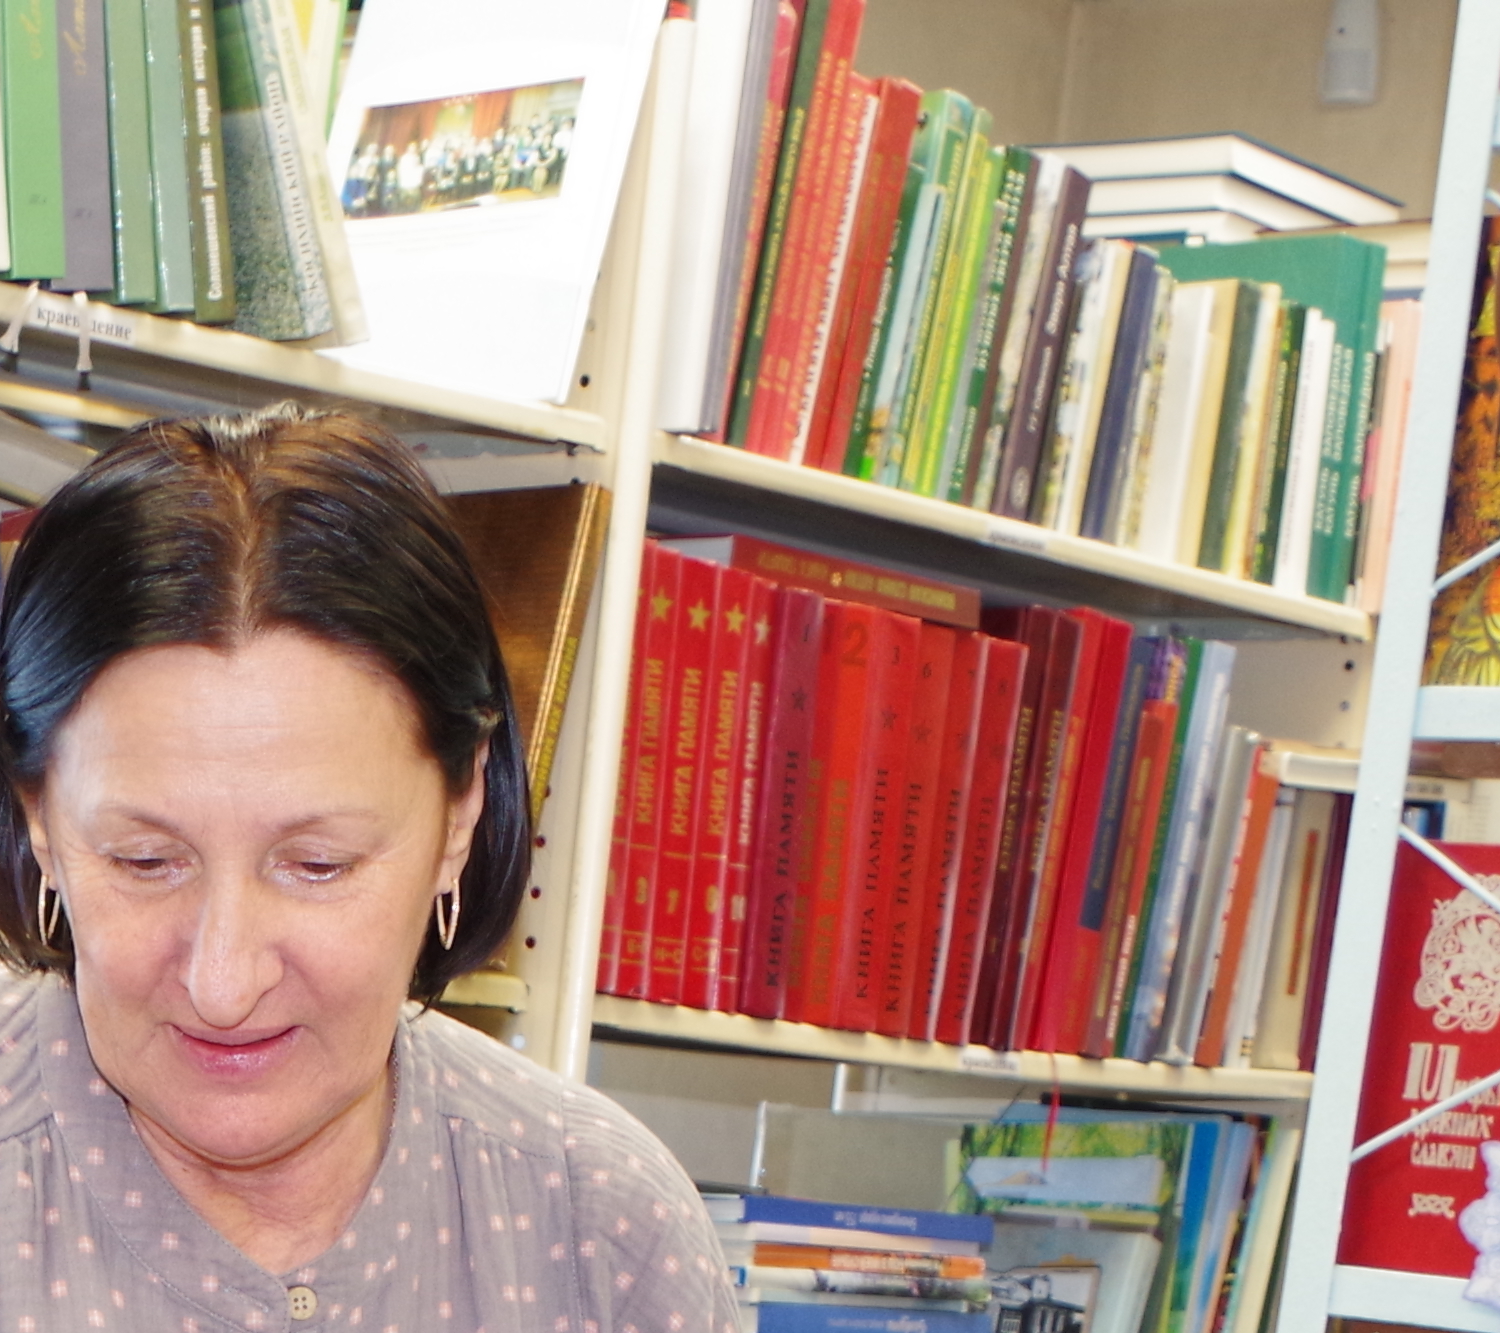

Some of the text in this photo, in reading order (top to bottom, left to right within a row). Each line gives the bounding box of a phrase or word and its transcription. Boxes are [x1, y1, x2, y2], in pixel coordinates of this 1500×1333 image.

[188, 23, 209, 81] истории
[193, 86, 213, 136] очерки
[839, 620, 871, 669] 2
[632, 656, 665, 824] КНИГА ПАМЯТИ
[668, 666, 702, 835] КНИГА ПАМЯТИ
[705, 668, 740, 835] КНИГА ПАМЯТИ
[736, 679, 766, 846] КНИГА ПАМЯТИ
[764, 748, 803, 988] КНИГА ПАМЯТИ
[854, 766, 891, 999] КНИГА ПАМЯТИ
[883, 782, 923, 1013] КНИГА ПАМЯТИ
